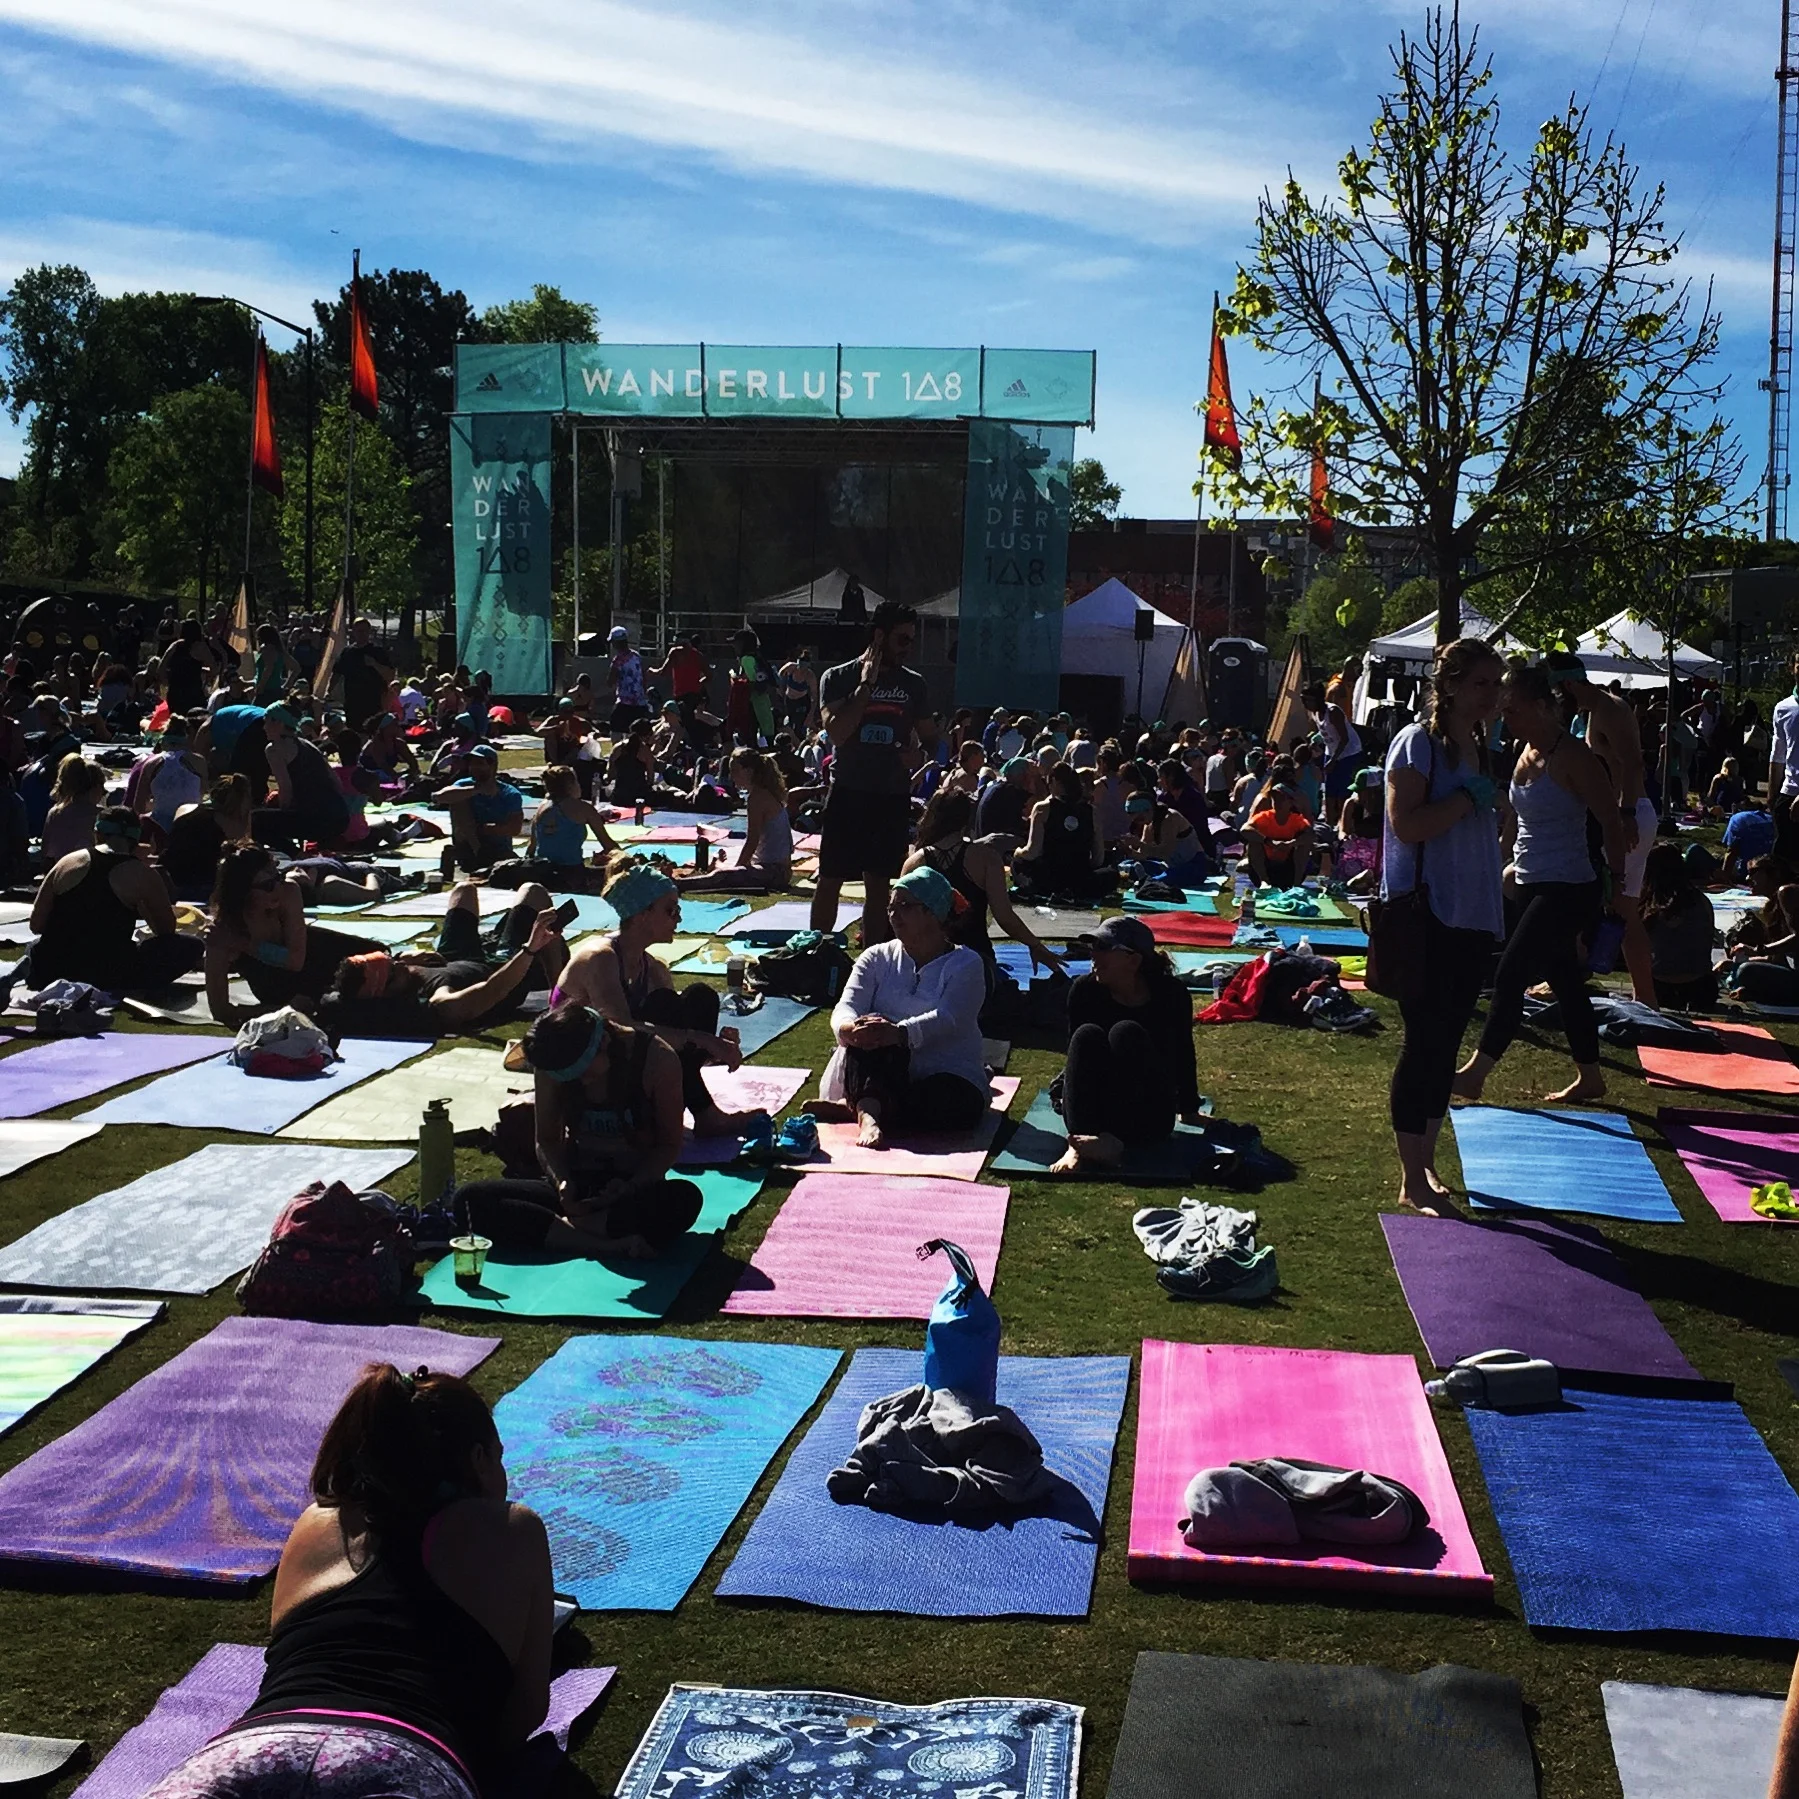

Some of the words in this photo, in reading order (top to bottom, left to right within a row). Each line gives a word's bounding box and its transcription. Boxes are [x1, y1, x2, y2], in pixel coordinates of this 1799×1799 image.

[581, 367, 881, 400] WANDERLUST
[472, 475, 530, 496] WAN
[474, 500, 531, 517] DER
[987, 508, 1048, 527] DER
[475, 522, 531, 541] LUST
[985, 532, 1048, 550] LUST
